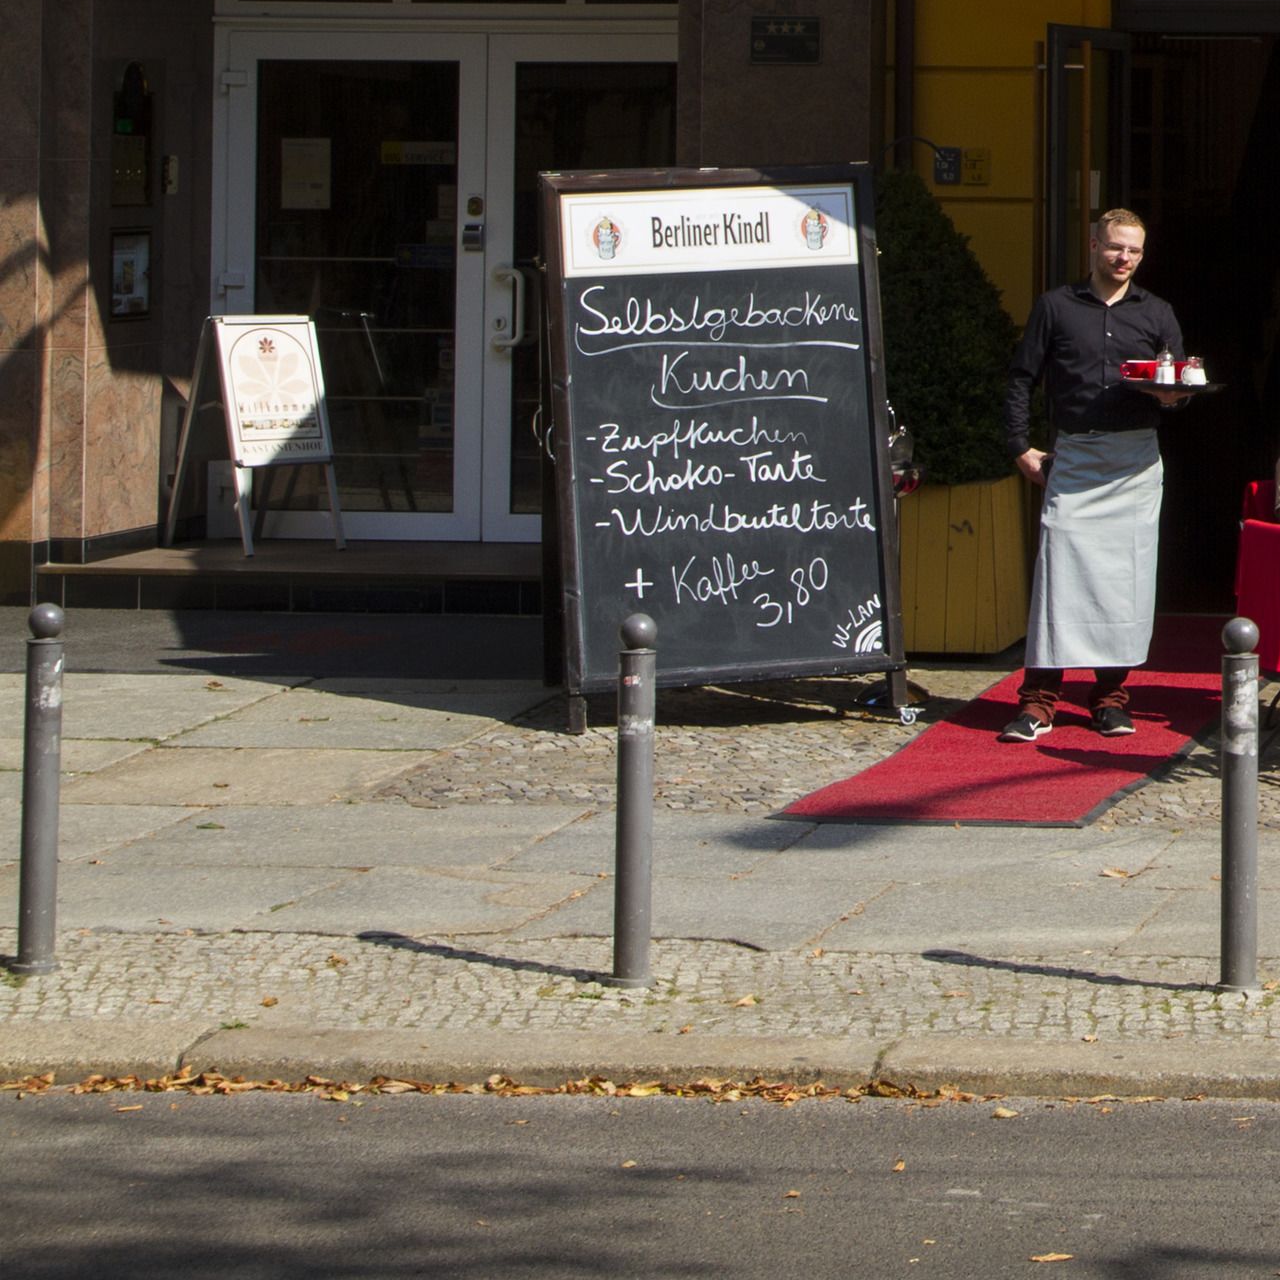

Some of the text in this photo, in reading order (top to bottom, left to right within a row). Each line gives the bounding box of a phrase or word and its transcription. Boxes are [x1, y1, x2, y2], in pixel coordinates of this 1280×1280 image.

[651, 214, 719, 248] Berliner
[722, 212, 770, 245] Kindl
[660, 350, 809, 395] Kuchen
[671, 552, 775, 606] Kaffee
[752, 556, 829, 628] 3,80
[832, 593, 882, 649] W-LAN
